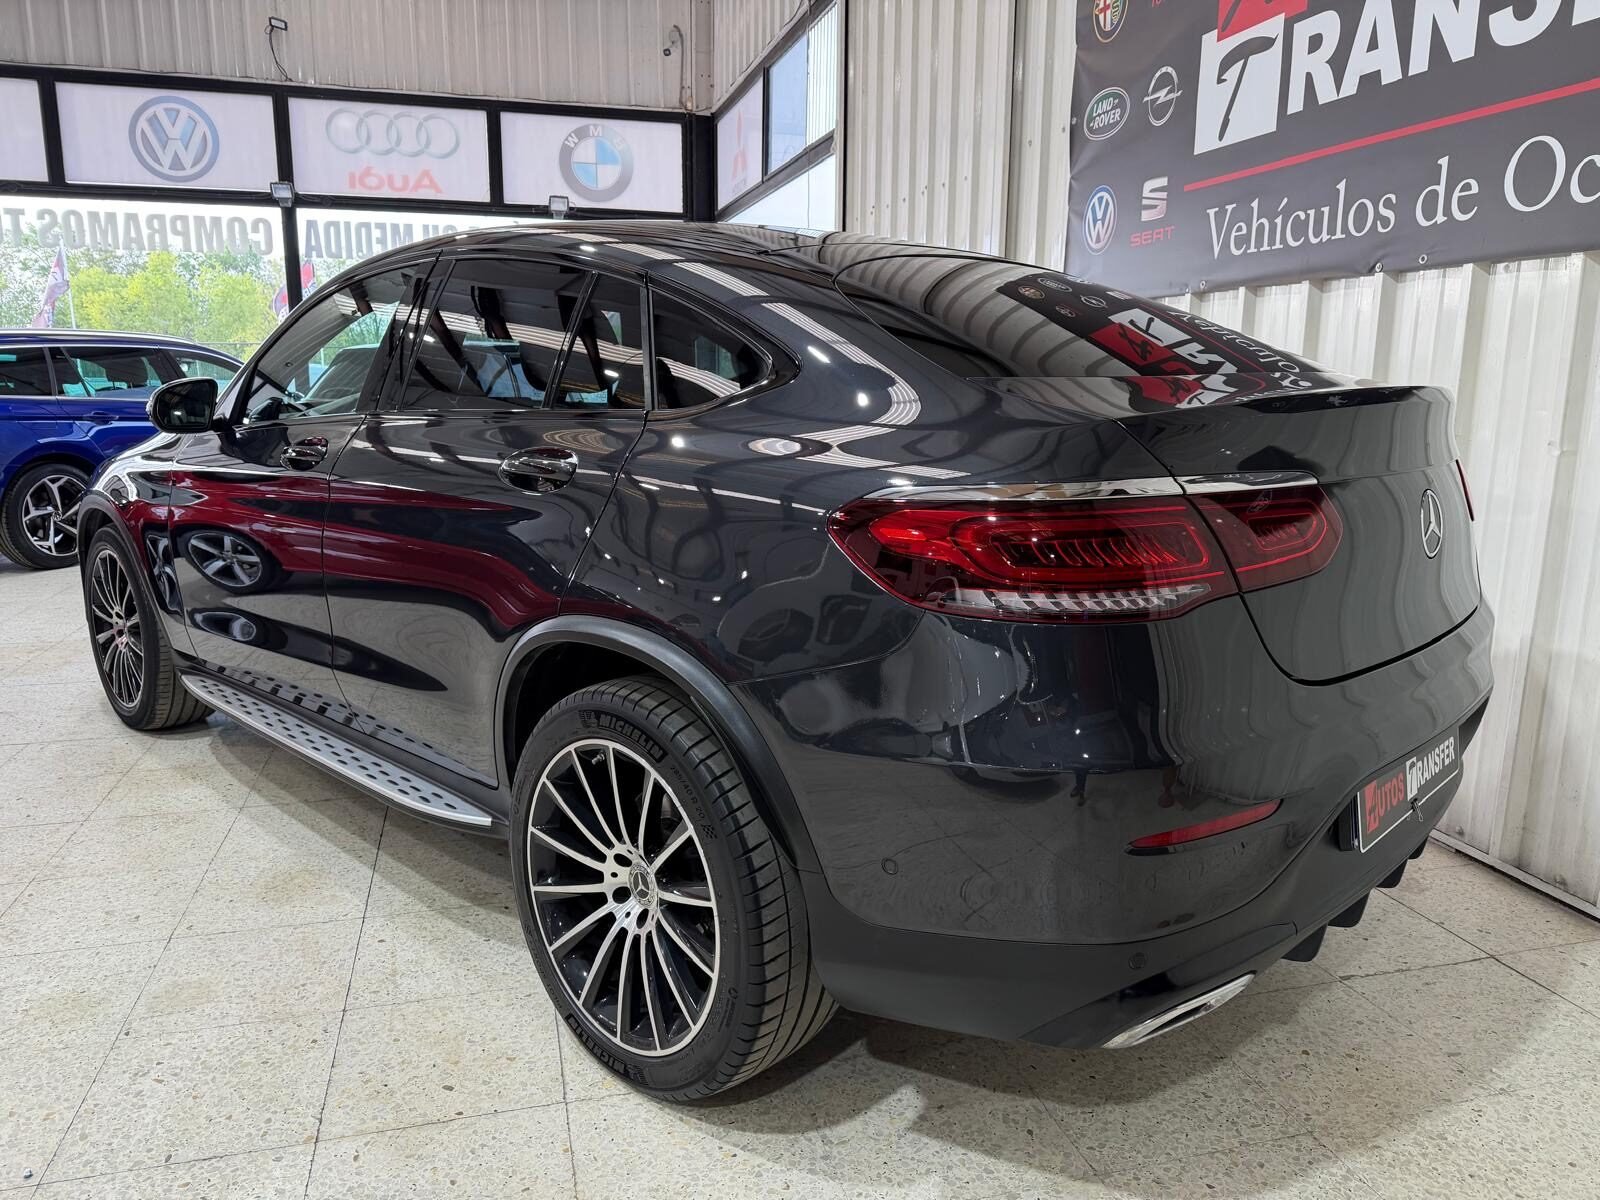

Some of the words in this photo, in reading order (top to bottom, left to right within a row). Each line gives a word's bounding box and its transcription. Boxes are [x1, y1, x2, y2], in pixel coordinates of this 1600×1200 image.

[1193, 0, 1600, 155] TRAN
[1092, 96, 1114, 117] LAND
[1092, 108, 1121, 130] ROVER
[1206, 178, 1397, 260] Vehículos
[1415, 155, 1479, 228] de
[1130, 226, 1175, 248] SEAT
[600, 713, 664, 758] MICHELIN
[1364, 771, 1404, 834] AUTOS
[1405, 736, 1455, 801] TRANSFER
